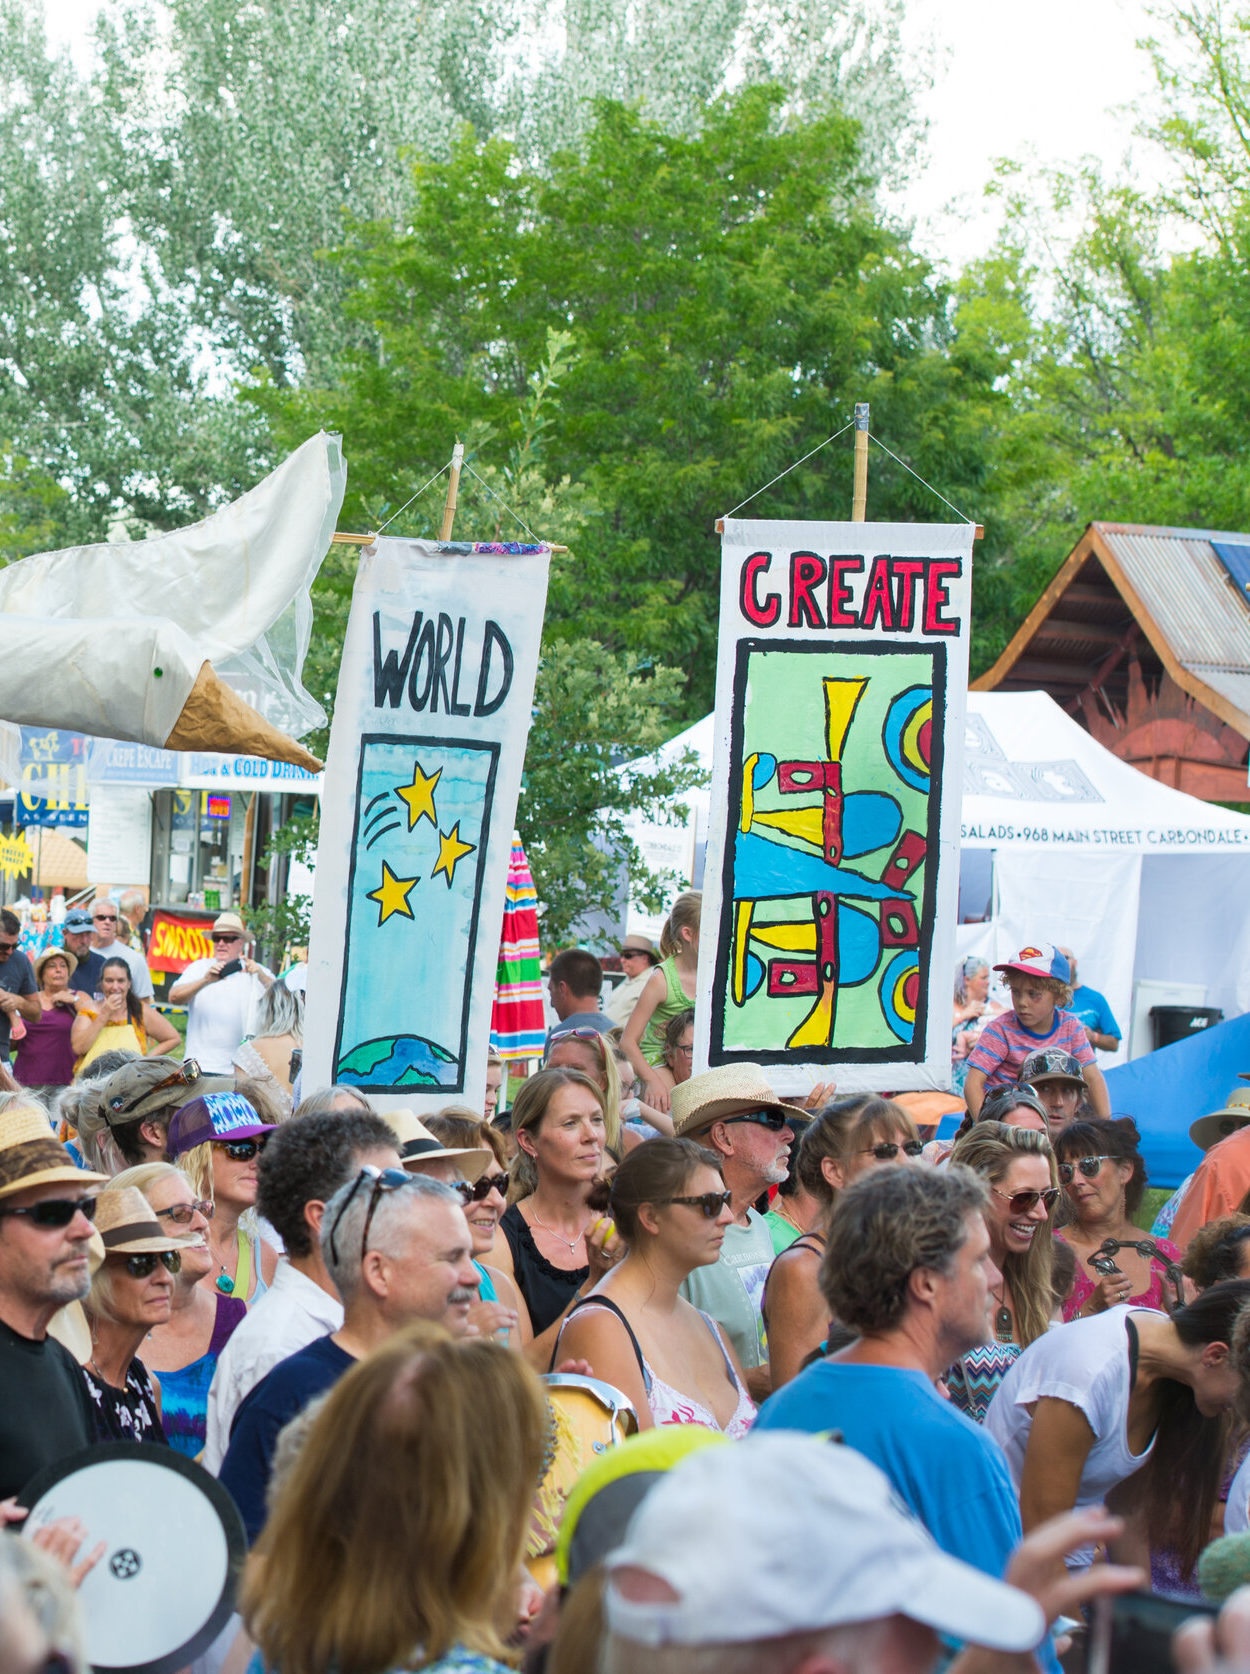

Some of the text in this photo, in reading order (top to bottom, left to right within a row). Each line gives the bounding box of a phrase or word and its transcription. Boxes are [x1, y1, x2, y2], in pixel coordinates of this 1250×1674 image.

[739, 551, 962, 637] CREATE
[372, 611, 515, 717] WORLD
[106, 745, 172, 770] CREPE ESCAPE
[234, 758, 268, 778] COLD
[1023, 827, 1048, 842] 968
[1052, 828, 1090, 843] MAIN
[1093, 829, 1142, 845] STREET
[1146, 829, 1242, 845] CARBONDALE
